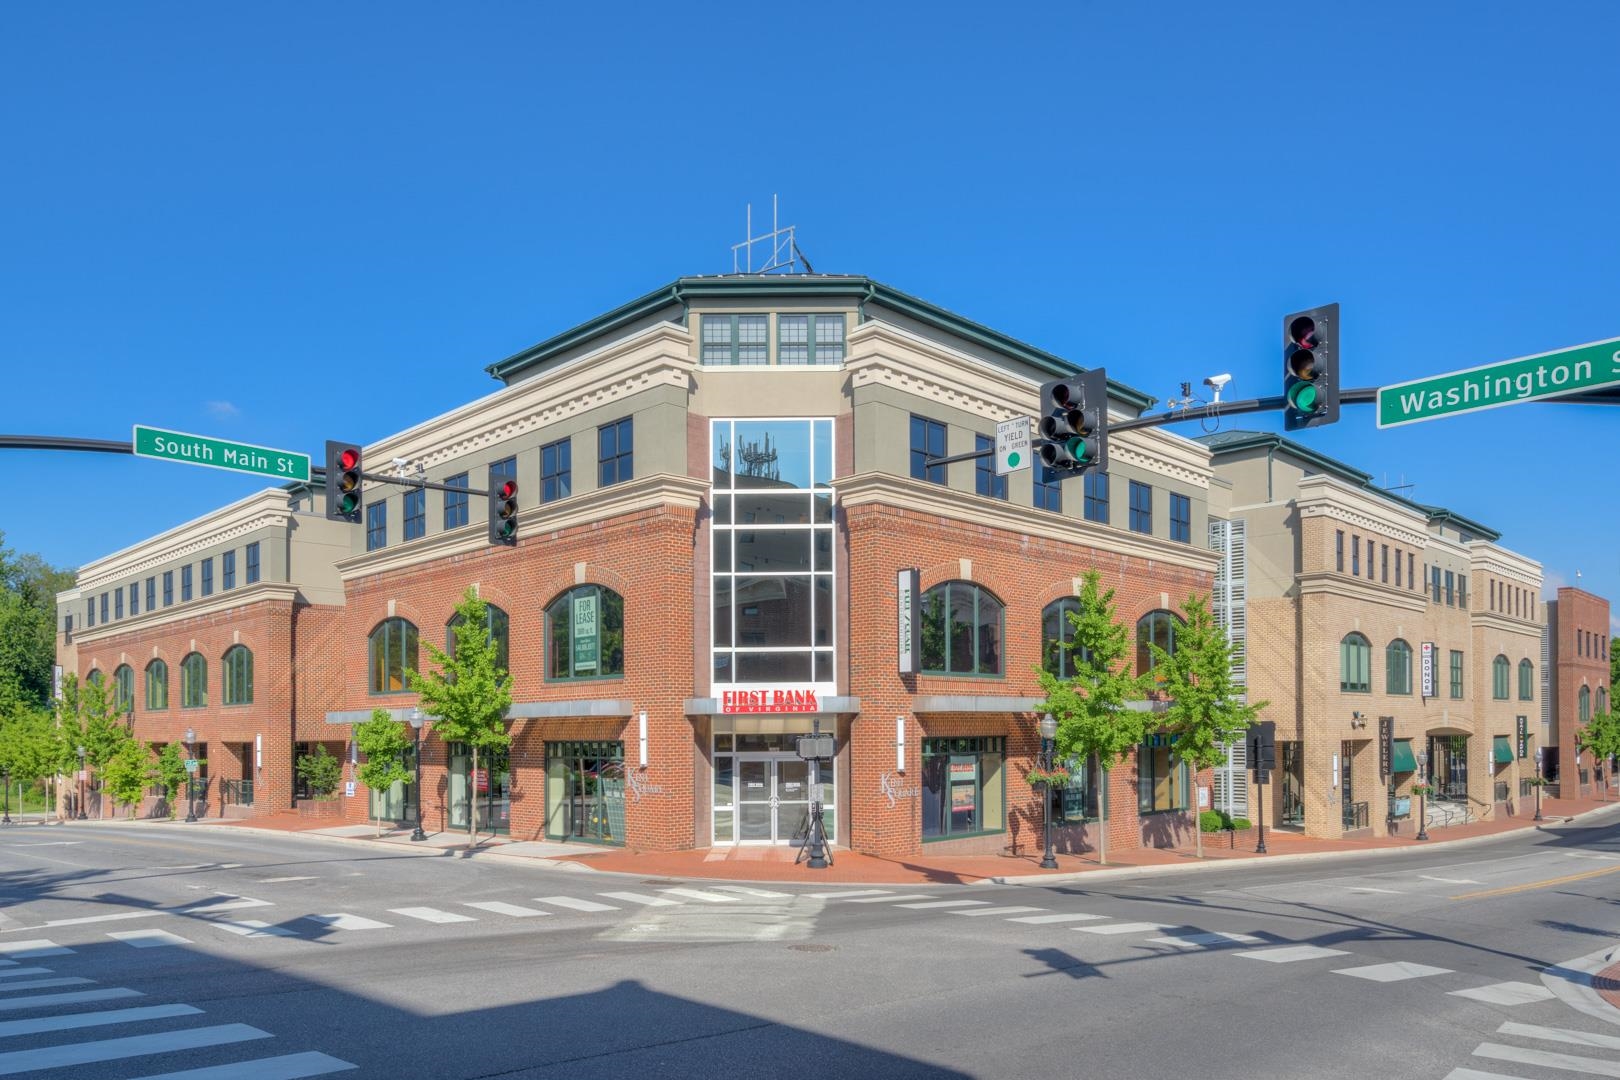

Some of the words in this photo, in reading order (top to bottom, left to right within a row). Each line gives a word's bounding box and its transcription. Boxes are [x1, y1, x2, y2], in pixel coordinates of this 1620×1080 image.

[1400, 360, 1592, 414] Washington
[998, 424, 1010, 434] LEFT
[1016, 420, 1029, 429] TURN
[1004, 430, 1023, 441] YIELD
[1011, 440, 1028, 449] GREEN
[154, 437, 213, 460] South
[224, 449, 268, 469] Main
[277, 458, 294, 474] St
[579, 599, 591, 612] FOR
[576, 611, 595, 625] LEASE
[723, 690, 769, 706] FIRST
[774, 689, 817, 706] BANK
[1381, 721, 1389, 773] JEWELERS
